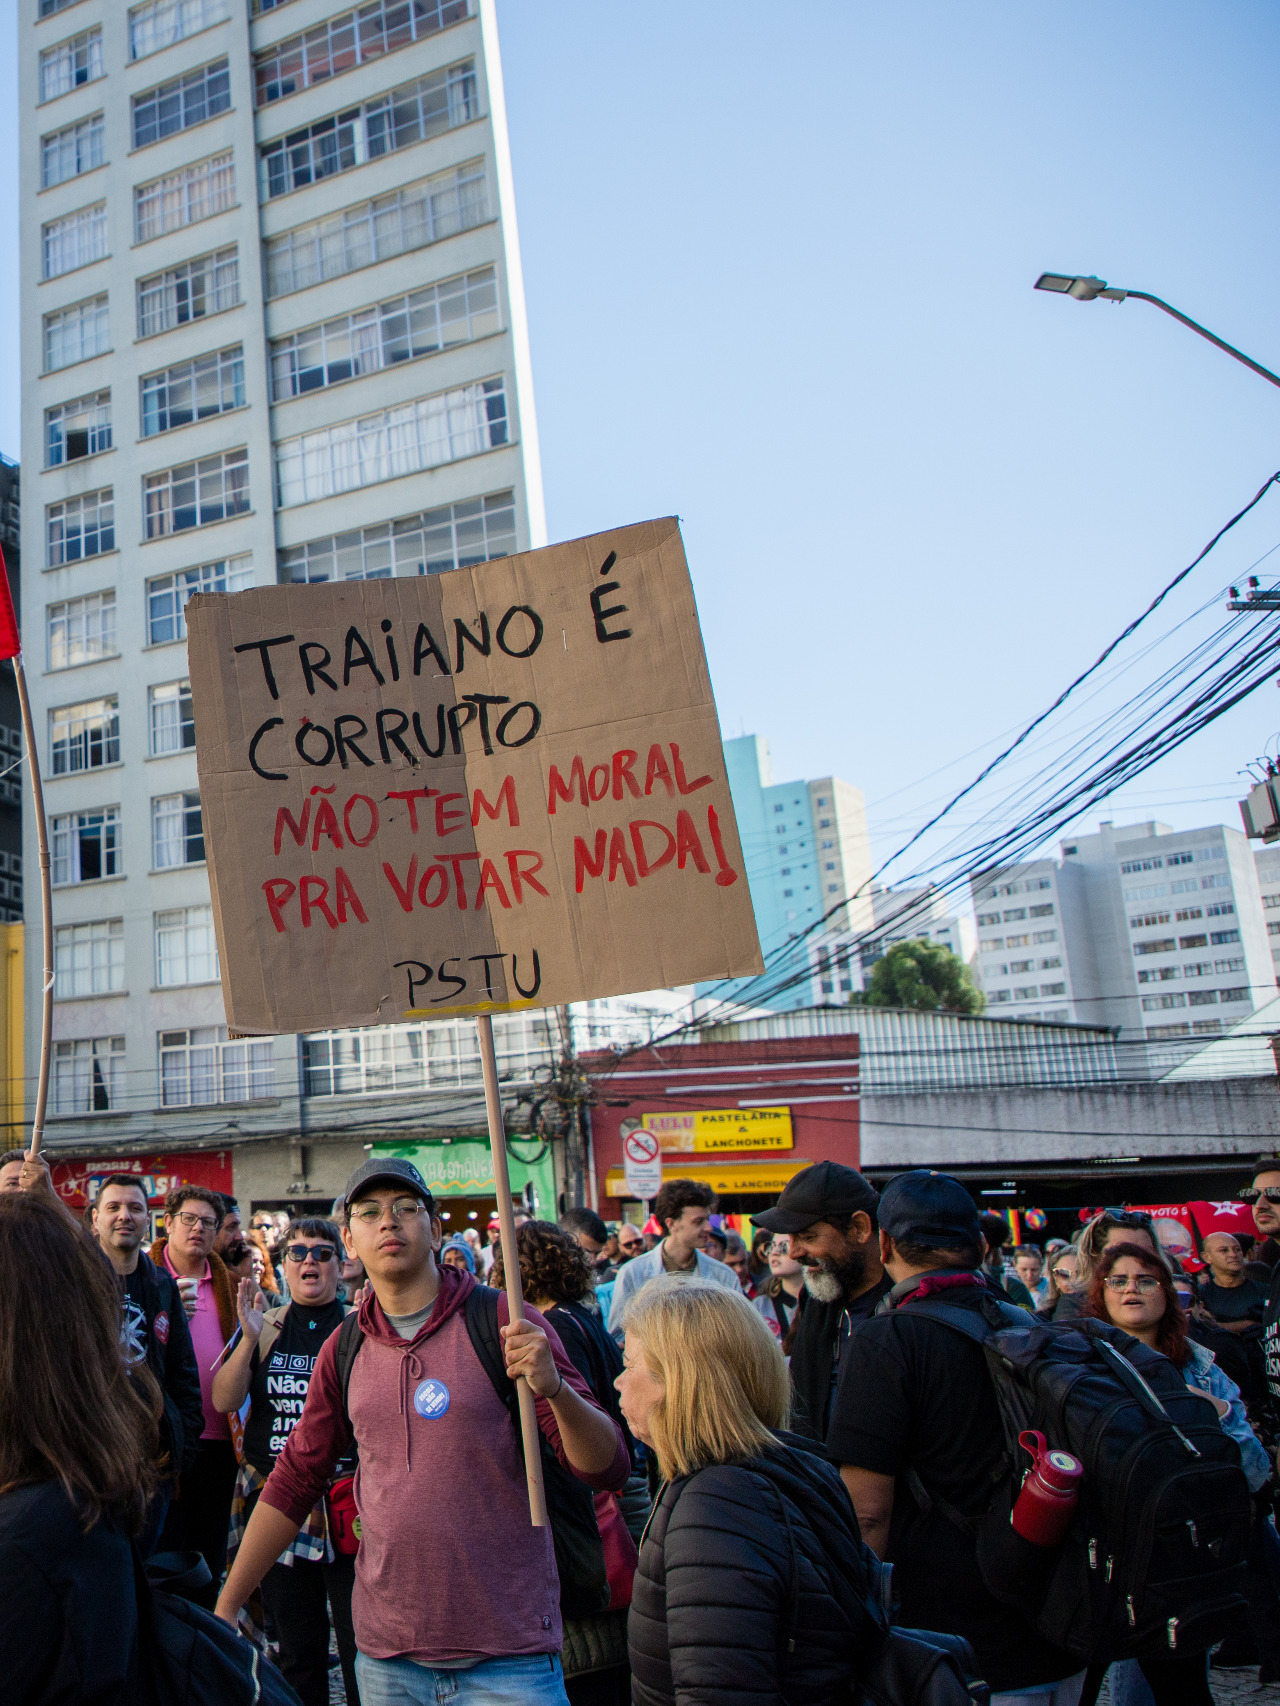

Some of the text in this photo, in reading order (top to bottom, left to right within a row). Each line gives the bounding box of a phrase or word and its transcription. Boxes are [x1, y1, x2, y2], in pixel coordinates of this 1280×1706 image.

[590, 550, 633, 644] É
[249, 693, 542, 780] CORRUPTO
[274, 742, 714, 856] NÃO TEM MORAL
[261, 804, 739, 934] PRA VOTAR NADA!
[393, 948, 542, 1008] PSTU
[648, 1116, 695, 1130] LULU
[702, 1111, 782, 1124] PASTELARIA
[704, 1137, 784, 1148] LANCHONETE
[1150, 1206, 1179, 1217] VOTO
[267, 1374, 310, 1395] Não
[269, 1398, 306, 1414] ven
